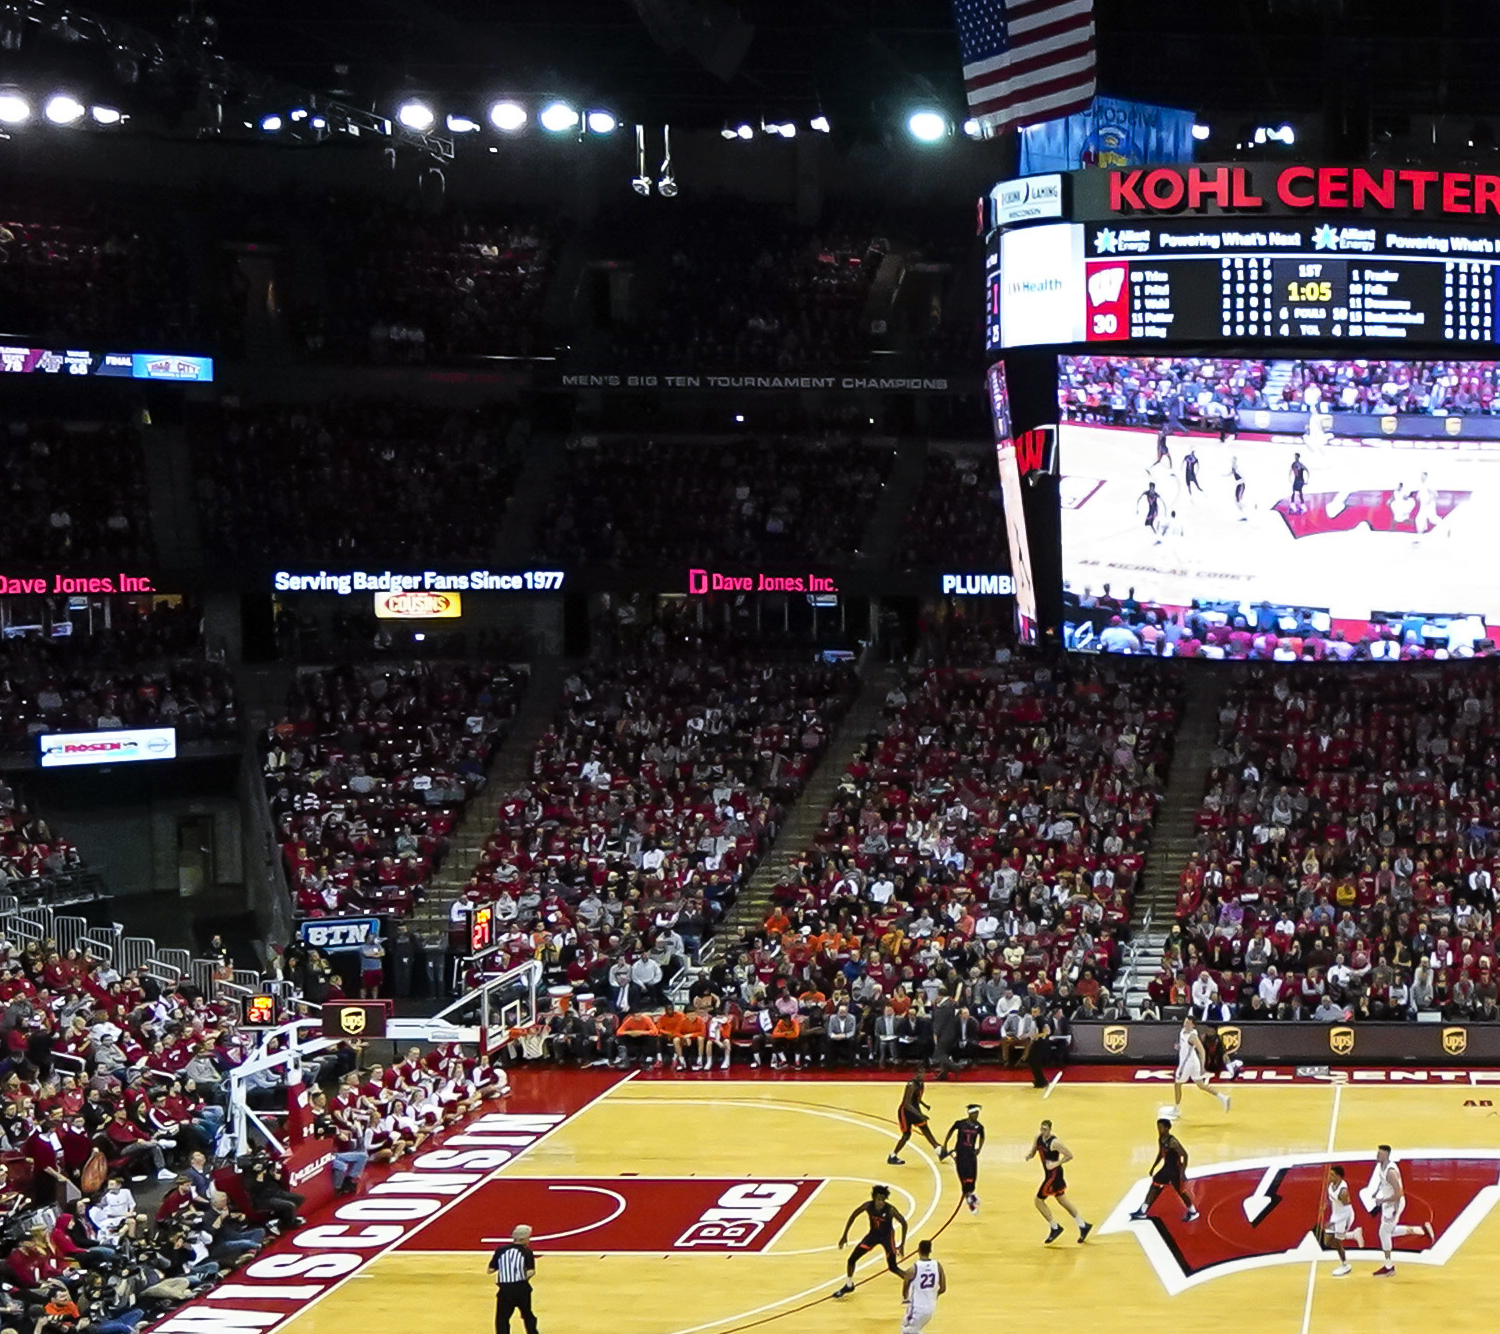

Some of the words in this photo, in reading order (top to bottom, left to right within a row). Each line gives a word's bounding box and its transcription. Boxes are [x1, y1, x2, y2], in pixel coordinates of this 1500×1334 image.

[1109, 167, 1263, 211] KOHL
[1159, 232, 1220, 249] Powering
[1221, 232, 1268, 247] What's
[1268, 232, 1301, 247] Next
[1386, 233, 1449, 253] Powering
[1450, 237, 1493, 253] What's
[1299, 264, 1323, 277] 1ST
[1288, 281, 1332, 301] 1:05
[1293, 308, 1326, 319] FOULS
[1093, 314, 1118, 334] 30
[1279, 324, 1289, 336] 4
[1332, 324, 1342, 337] 4
[105, 356, 133, 366] FINAL
[562, 374, 620, 386] MEN'S
[627, 375, 658, 387] BIG
[664, 375, 700, 387] TEN
[706, 375, 836, 388] TOURNAMENT
[841, 377, 948, 391] CHAMPIONS
[119, 573, 157, 592] Inc.
[275, 571, 351, 594] Serving
[353, 571, 422, 593] Badger
[424, 571, 469, 590] Fans
[470, 571, 522, 590] Since
[523, 571, 564, 590] 1977
[712, 573, 752, 591] Dave
[809, 573, 839, 592] Inc.
[388, 597, 447, 613] COUSINS
[64, 742, 121, 754] ROSEN
[308, 924, 370, 946] BTN
[473, 923, 489, 950] 27
[250, 1008, 270, 1023] 27
[344, 1017, 363, 1031] ups
[1106, 1036, 1125, 1050] ups
[1332, 1036, 1351, 1051] ups
[1446, 1036, 1465, 1051] ups
[919, 1272, 935, 1289] 23
